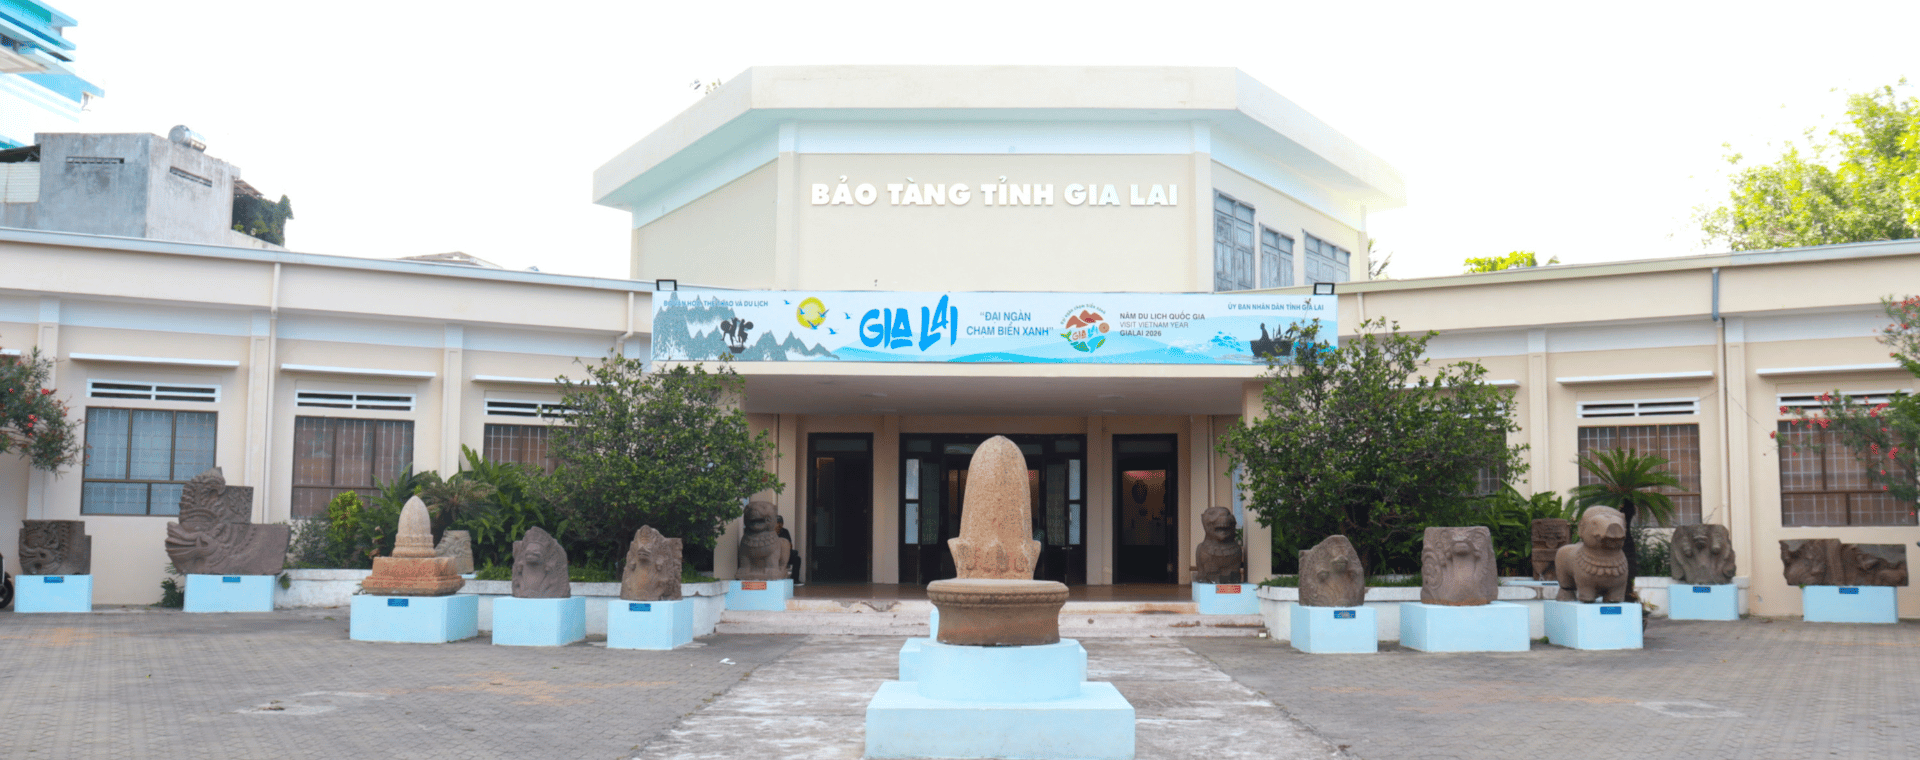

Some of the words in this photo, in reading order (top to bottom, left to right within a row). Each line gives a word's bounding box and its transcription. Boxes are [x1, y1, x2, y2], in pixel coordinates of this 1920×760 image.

[811, 175, 877, 206] BẢO
[887, 176, 971, 206] TÀNG
[981, 175, 1054, 206] TỈNH
[1064, 183, 1121, 206] GIA
[1129, 183, 1178, 206] LAI
[735, 299, 743, 307] VÀ
[754, 300, 769, 309] LỊCH
[1302, 303, 1313, 311] GIA
[1003, 309, 1031, 321] NGÀN
[1138, 312, 1149, 320] DU
[1168, 310, 1191, 320] QUỐC
[859, 307, 913, 350] GIA
[919, 294, 958, 352] LAI
[1138, 321, 1169, 329] VIETNAM
[1170, 321, 1189, 329] YEAR
[966, 325, 995, 339] CHẠM
[997, 321, 1020, 336] BIỂN
[1119, 329, 1144, 337] GIALAI
